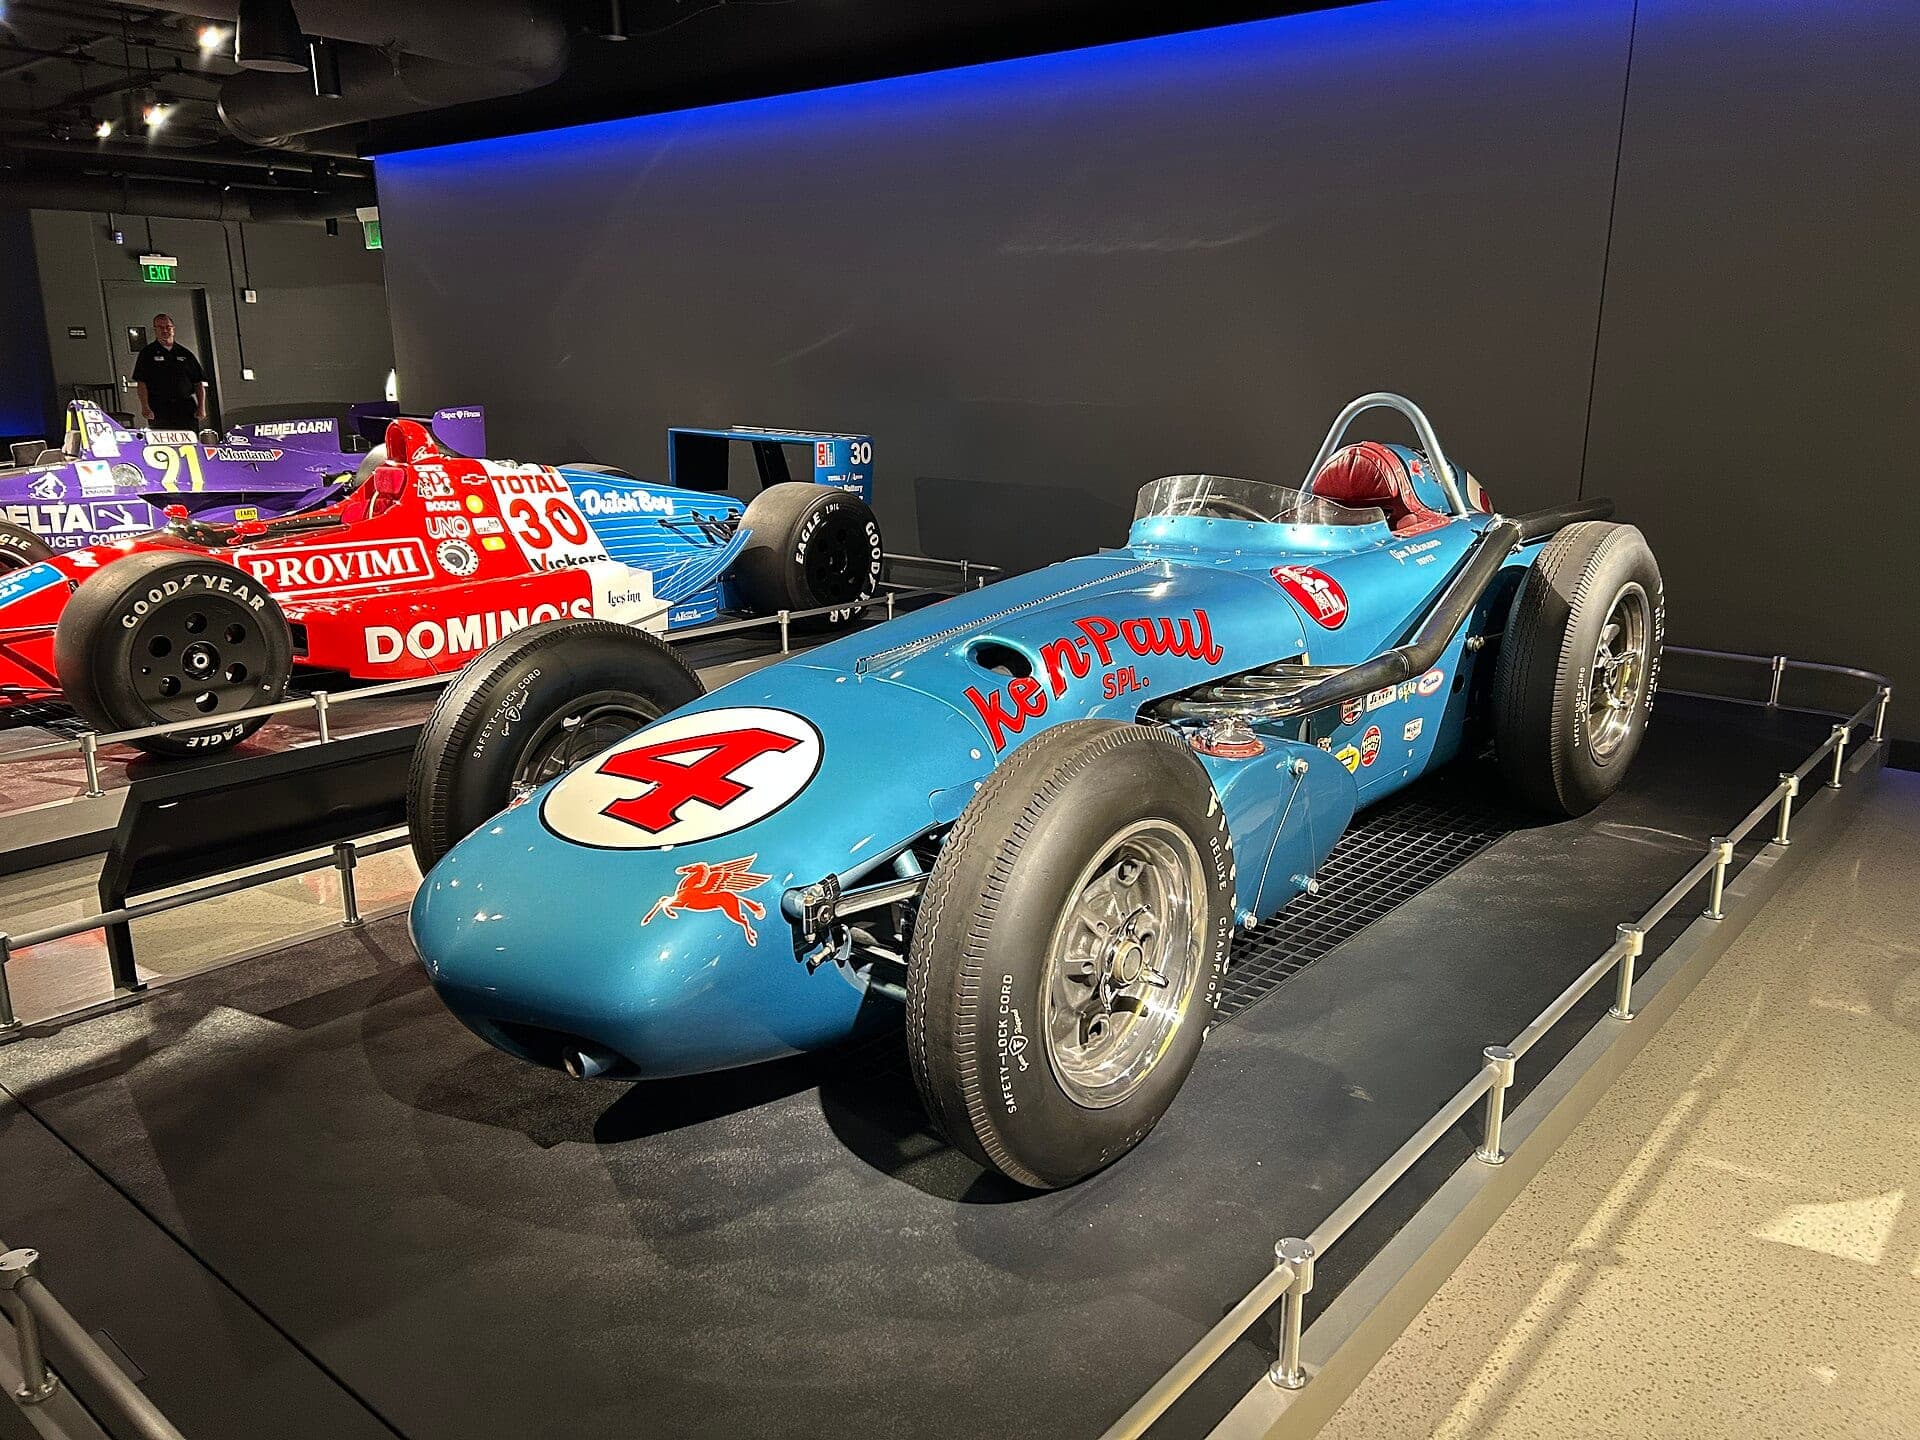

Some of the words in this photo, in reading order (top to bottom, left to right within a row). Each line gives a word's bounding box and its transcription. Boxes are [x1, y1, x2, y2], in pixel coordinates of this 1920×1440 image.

[149, 265, 170, 280] EXIT
[152, 432, 192, 443] XEROX
[254, 421, 333, 437] HEMELGARN
[143, 444, 205, 493] 91
[219, 448, 274, 461] Montana
[850, 442, 872, 465] 30
[491, 474, 568, 495] TOTAL
[426, 500, 461, 512] BOSCH
[580, 488, 635, 517] Dutch
[631, 490, 675, 516] Boy
[424, 515, 471, 539] UNO
[509, 497, 588, 549] 30
[795, 511, 821, 565] EAGLE
[42, 534, 84, 548] UCET
[248, 547, 420, 589] PROVIMI
[1102, 665, 1150, 700] SPL.
[473, 689, 519, 759] SAFETY-LOCK
[517, 668, 542, 690] CORD
[185, 723, 245, 748] EAGLE
[594, 726, 805, 835] 4
[1208, 836, 1227, 892] DELUXE
[1204, 915, 1228, 1004] CHAMPION
[1000, 973, 1014, 1015] CORD
[998, 1018, 1018, 1115] SAFETY-LOCK
